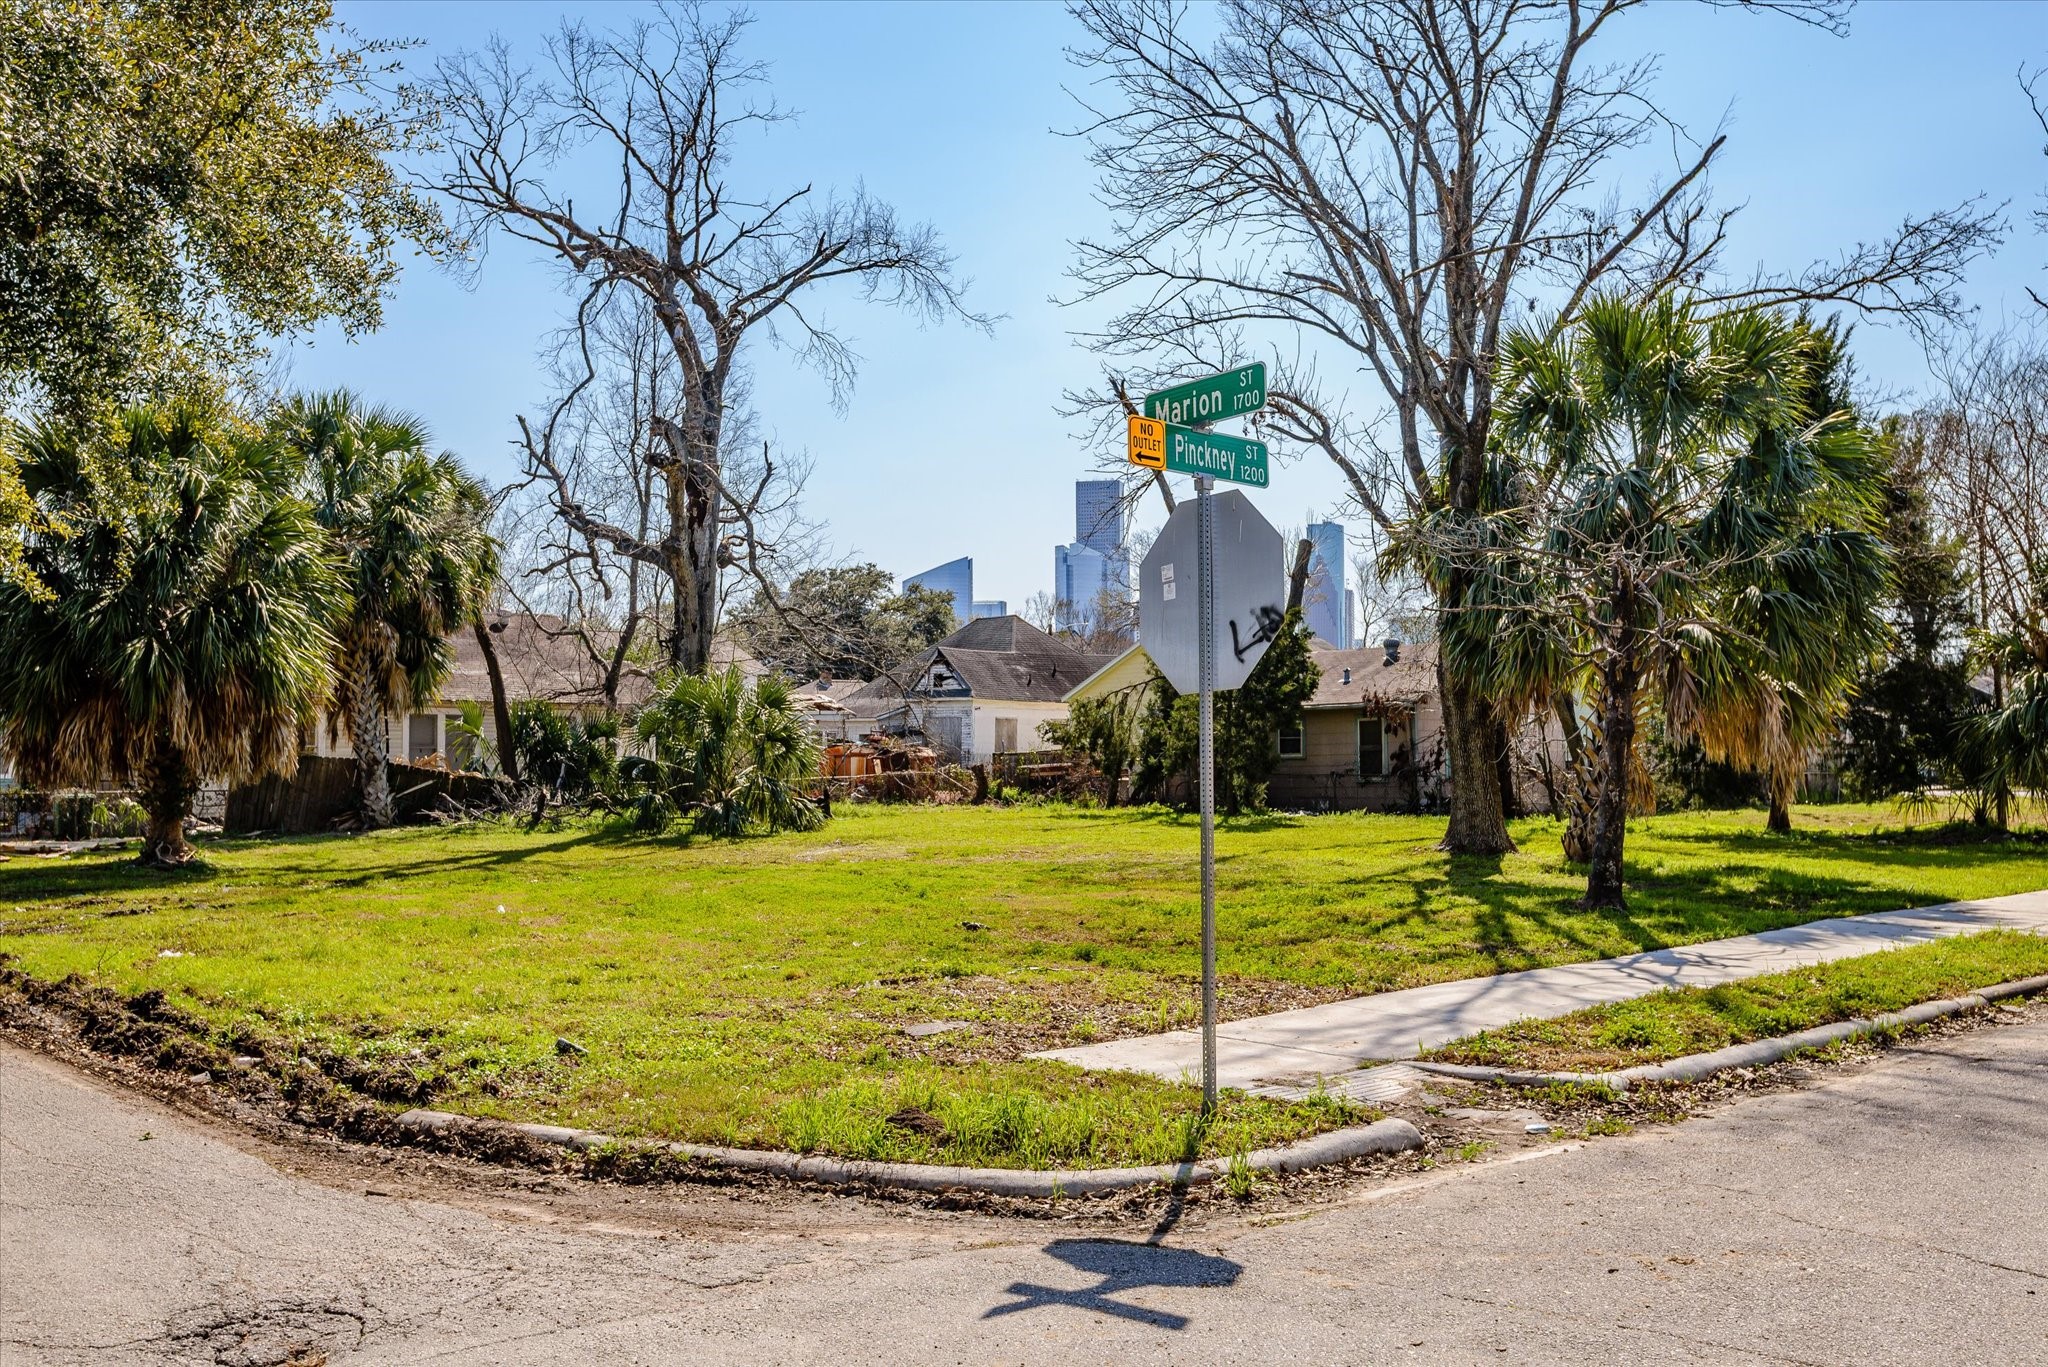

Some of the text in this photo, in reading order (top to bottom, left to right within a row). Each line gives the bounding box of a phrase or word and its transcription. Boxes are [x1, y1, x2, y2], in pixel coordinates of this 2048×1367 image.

[1239, 369, 1253, 387] ST
[1155, 390, 1222, 423] Marion
[1233, 389, 1260, 410] 1700
[1140, 423, 1154, 437] NO
[1133, 436, 1161, 452] OUTLET
[1245, 445, 1258, 460] ST
[1175, 434, 1235, 480] Pinckney
[1240, 465, 1265, 483] 1200
